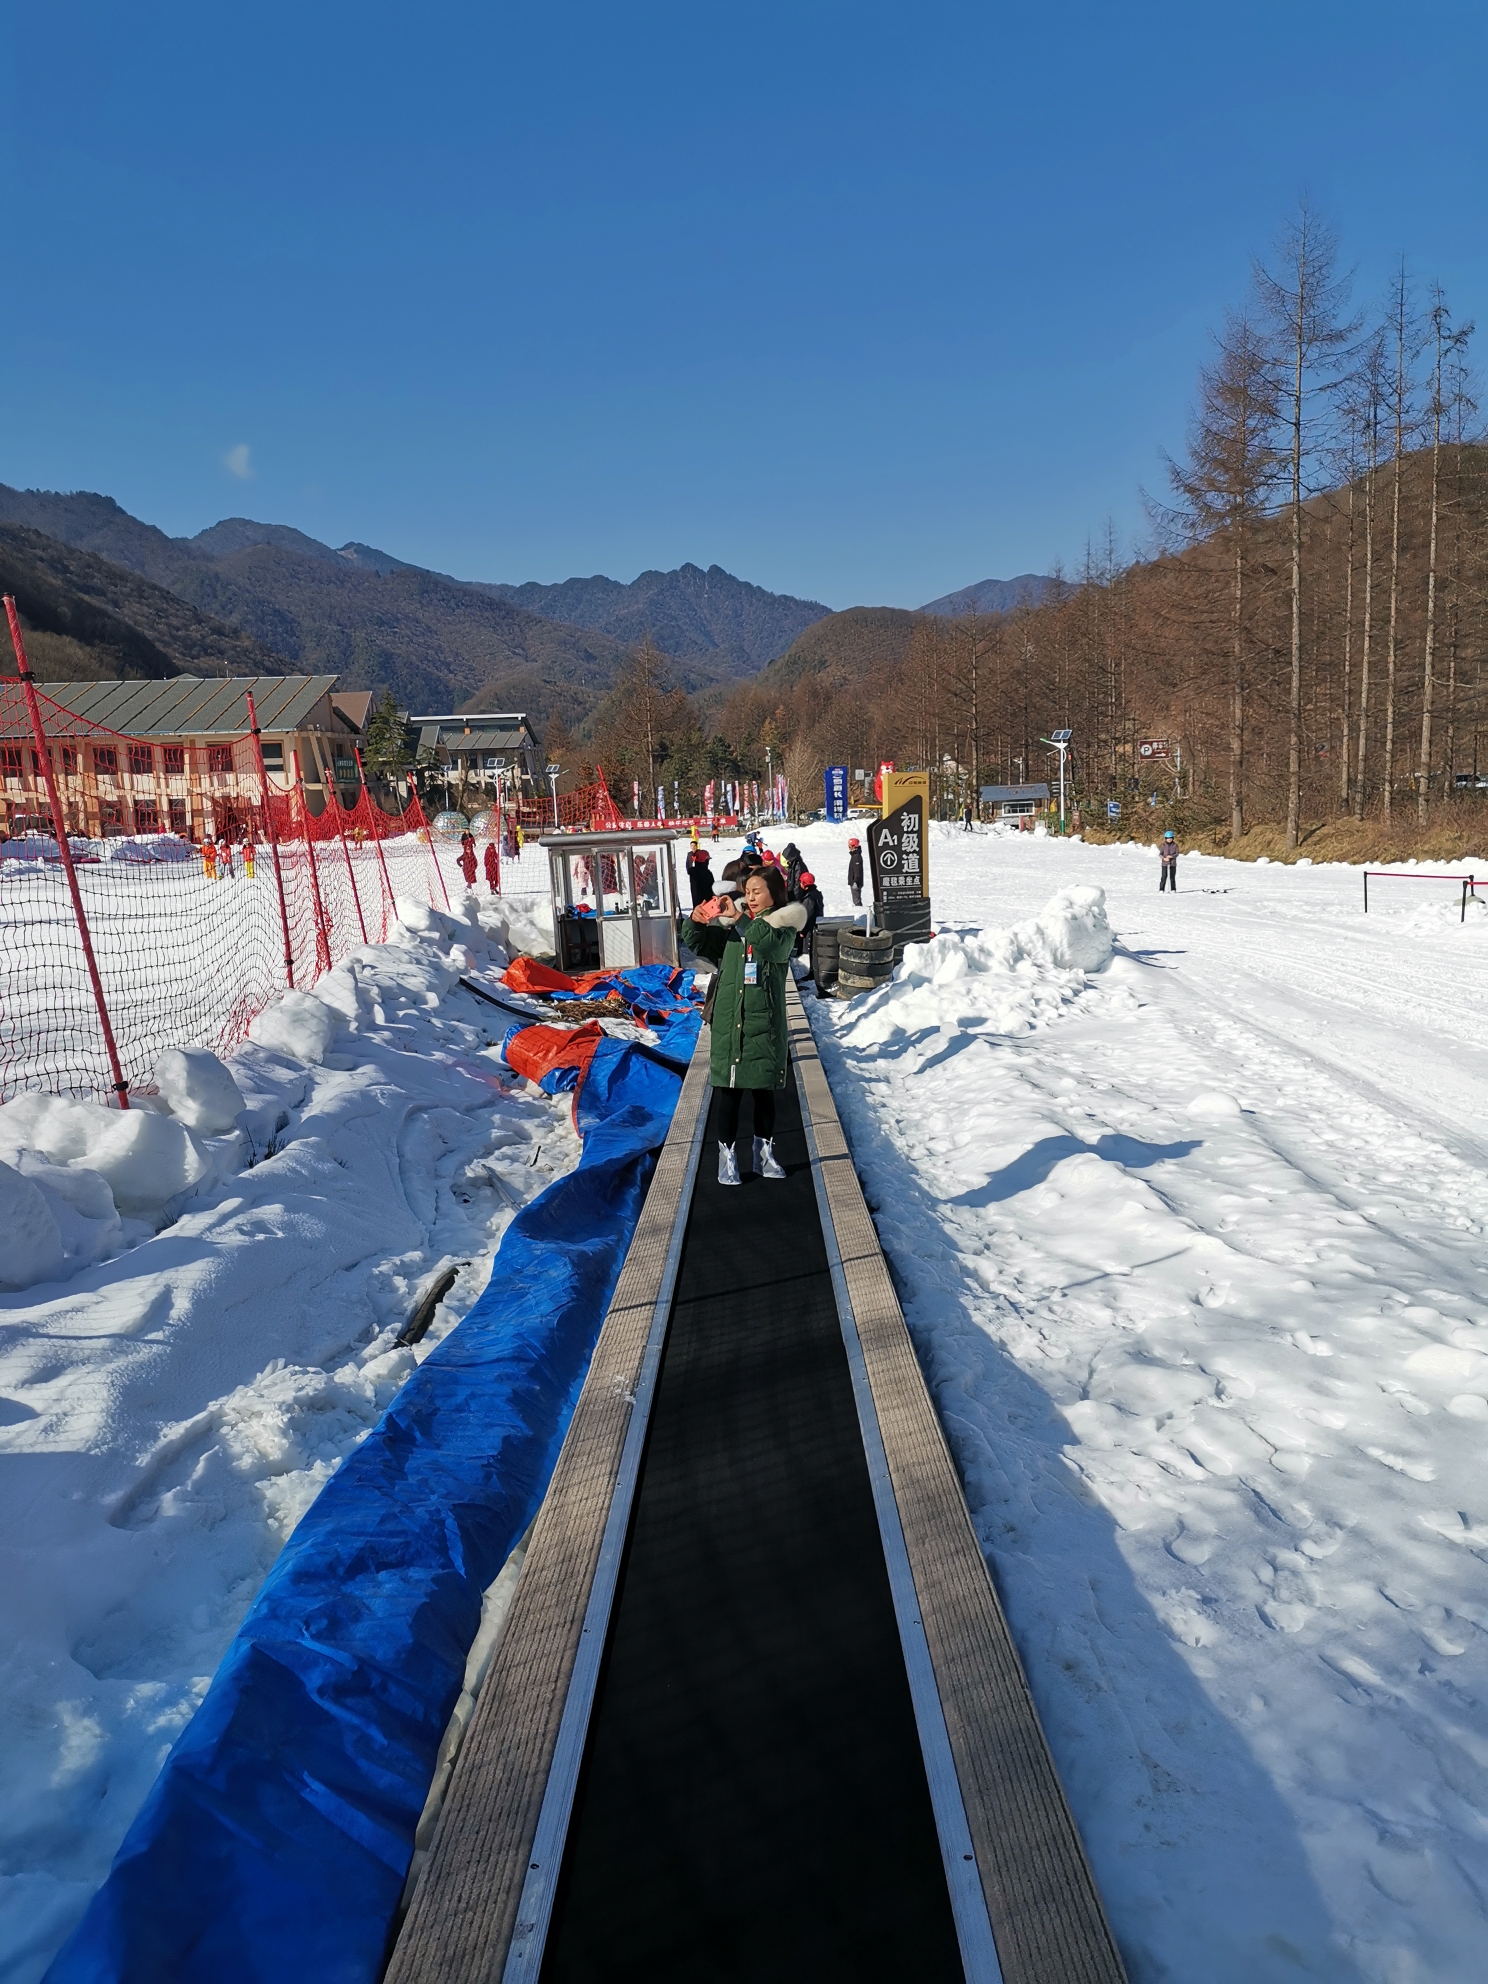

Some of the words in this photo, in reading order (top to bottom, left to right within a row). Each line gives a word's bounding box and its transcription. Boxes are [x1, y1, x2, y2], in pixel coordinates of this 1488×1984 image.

[878, 829, 898, 846] A1
[901, 812, 919, 873] 初级道
[882, 875, 921, 886] 魔毯乘坐点
